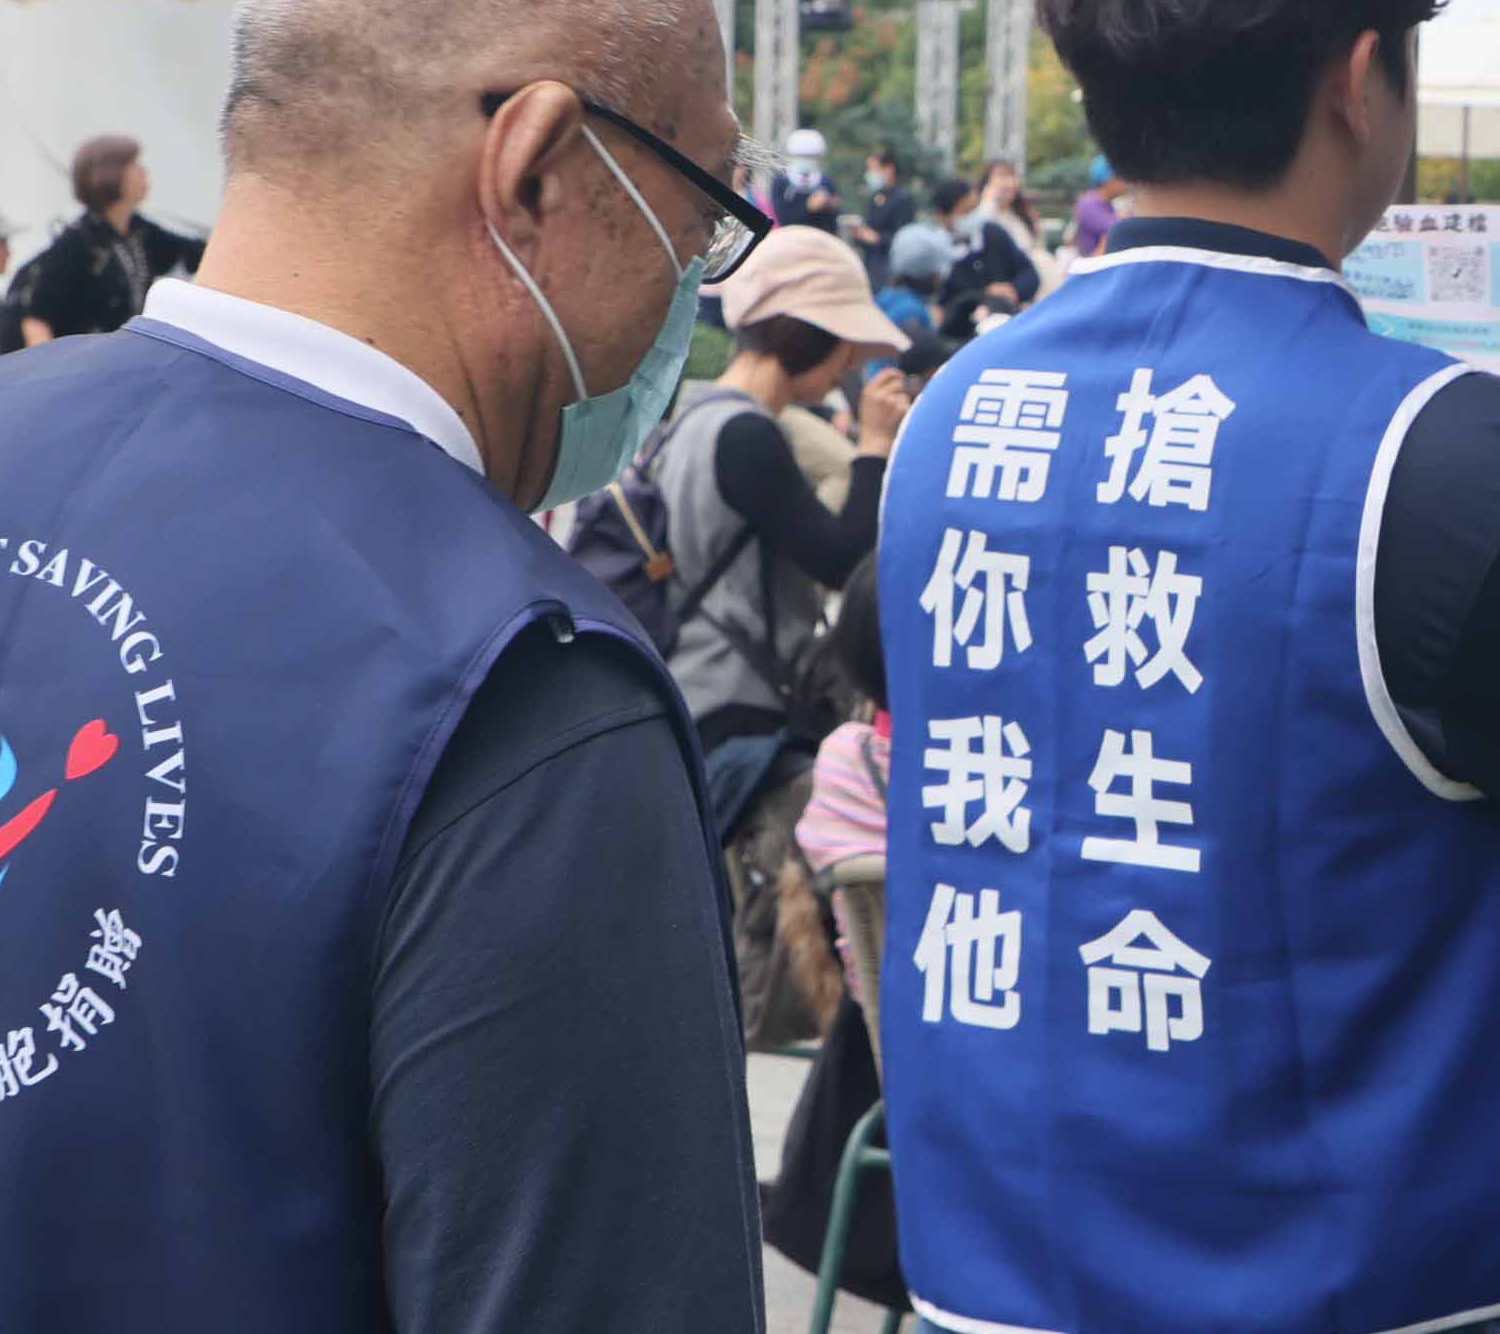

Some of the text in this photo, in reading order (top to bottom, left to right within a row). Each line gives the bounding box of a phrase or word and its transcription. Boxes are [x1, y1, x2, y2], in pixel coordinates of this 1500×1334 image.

[9, 538, 164, 675] SAVING
[135, 678, 187, 878] LIVES
[913, 368, 1071, 1029] 需你我他
[1079, 368, 1236, 1052] 搶救生命
